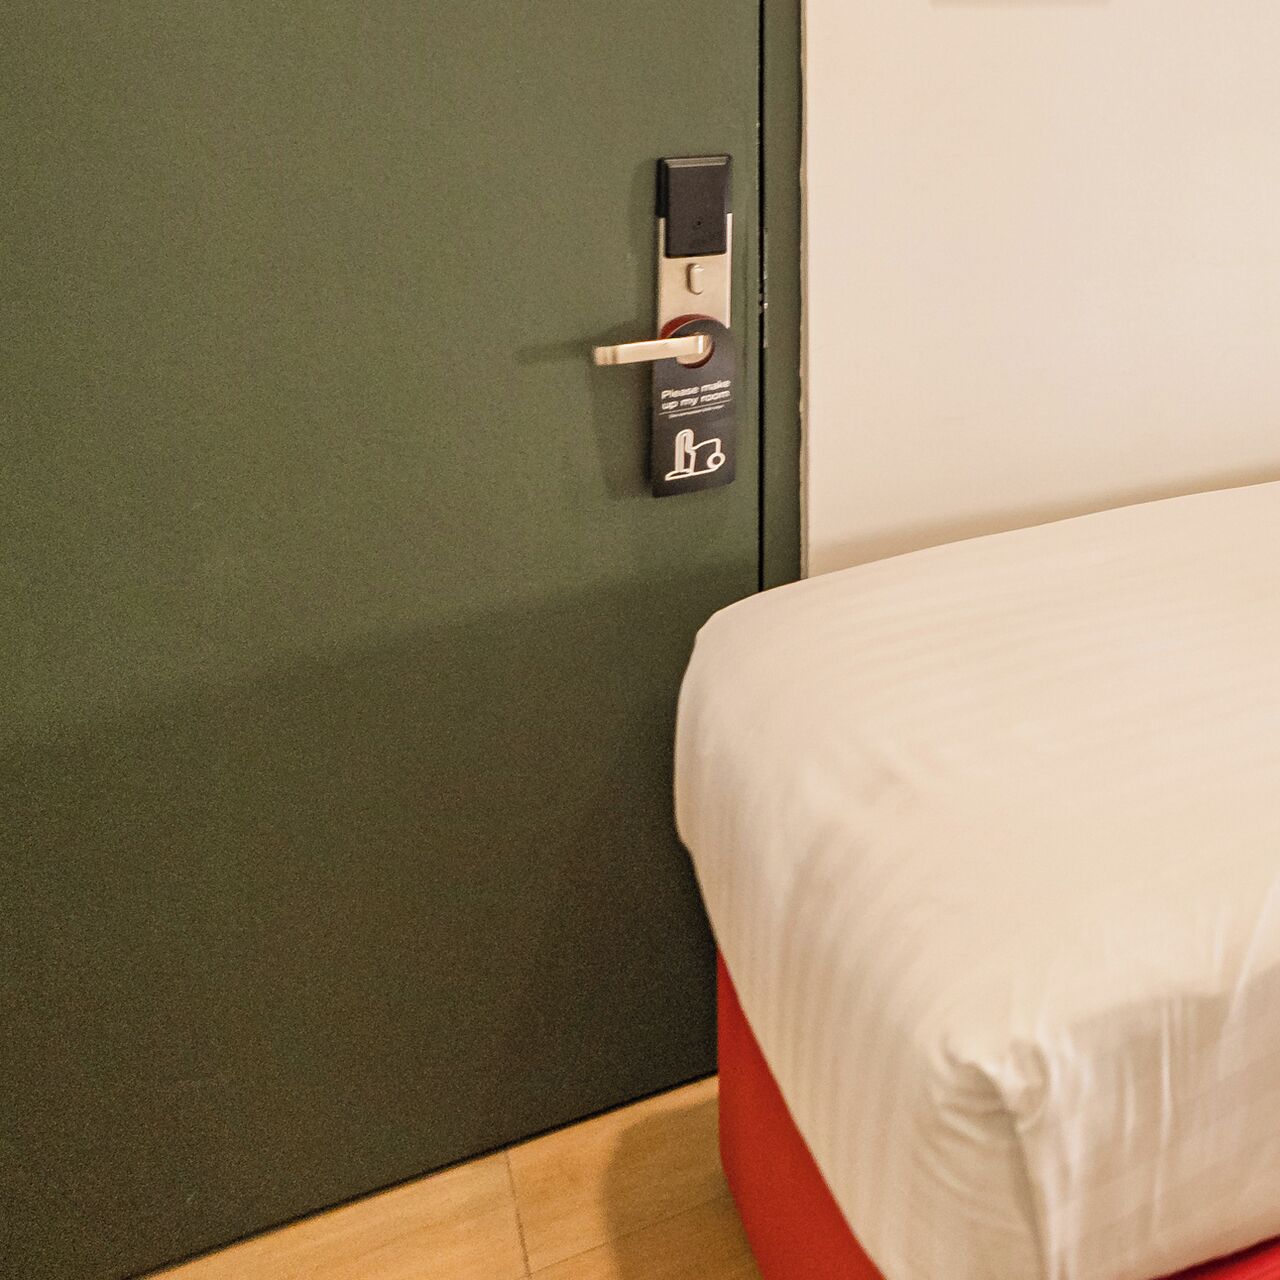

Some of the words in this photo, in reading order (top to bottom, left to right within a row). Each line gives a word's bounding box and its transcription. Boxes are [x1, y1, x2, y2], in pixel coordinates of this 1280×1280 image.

[661, 387, 700, 400] Please
[701, 380, 731, 392] make
[662, 401, 679, 410] up
[680, 396, 699, 407] my
[701, 390, 731, 402] room
